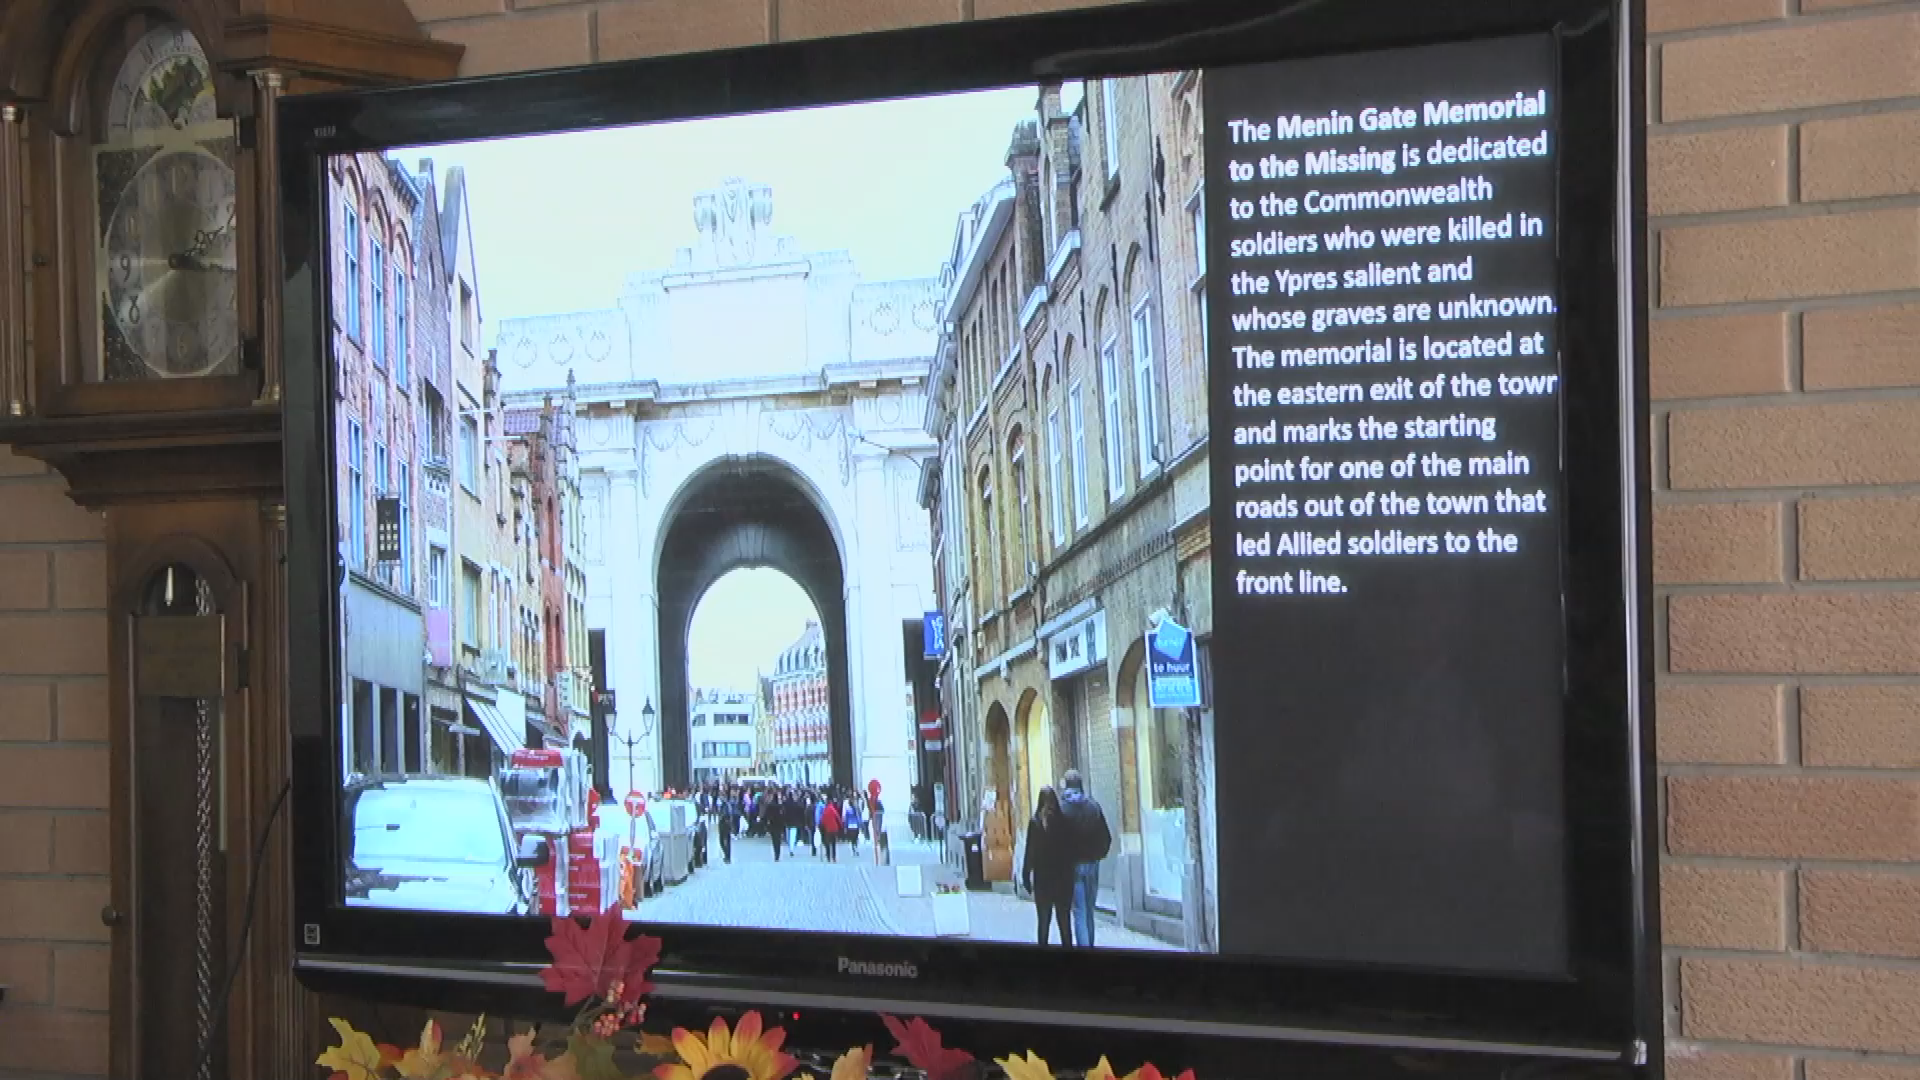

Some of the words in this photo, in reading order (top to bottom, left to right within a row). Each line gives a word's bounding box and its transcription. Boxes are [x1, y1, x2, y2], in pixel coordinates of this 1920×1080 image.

[1228, 119, 1271, 144] The
[1277, 110, 1352, 139] Menin
[1359, 107, 1417, 131] Gate
[1424, 90, 1545, 126] Memorial
[1229, 160, 1254, 182] to
[1259, 154, 1299, 178] the
[1305, 146, 1396, 175] Missing
[1403, 144, 1421, 168] is
[1427, 130, 1547, 164] dedicated
[1230, 198, 1254, 220] to
[1259, 192, 1298, 216] the
[1304, 175, 1492, 214] Commonwealth
[1231, 231, 1318, 256] soldiers
[1324, 224, 1375, 250] who
[1381, 226, 1441, 246] were
[1449, 212, 1512, 242] killed
[1520, 212, 1542, 236] in
[1231, 270, 1269, 294] the
[1275, 270, 1337, 296] Ypres
[1343, 262, 1421, 288] salient
[1428, 256, 1472, 282] and
[1232, 306, 1306, 332] whose
[1312, 306, 1387, 332] graves
[1393, 302, 1431, 322] are
[1439, 294, 1556, 320] unknown.
[1232, 346, 1275, 368] The
[1281, 338, 1391, 366] memorial
[1399, 338, 1417, 360] is
[1424, 331, 1512, 360] located
[1520, 332, 1544, 354] at
[1233, 384, 1271, 406] the
[1277, 382, 1363, 404] eastern
[1370, 376, 1413, 400] exit
[1420, 374, 1445, 398] of
[1451, 372, 1492, 398] the
[1234, 420, 1276, 444] and
[1284, 418, 1352, 442] marks
[1358, 416, 1398, 439] the
[1404, 412, 1496, 440] starting
[1235, 458, 1294, 487] point
[1299, 456, 1333, 480] for
[1339, 460, 1384, 479] one
[1391, 452, 1416, 478] of
[1421, 452, 1462, 476] the
[1469, 450, 1529, 476] main
[1236, 494, 1298, 518] roads
[1304, 494, 1344, 516] out
[1350, 492, 1375, 516] of
[1380, 490, 1420, 515] the
[1426, 492, 1488, 514] town
[1495, 488, 1546, 512] that
[1237, 532, 1270, 556] led
[1277, 530, 1341, 556] Allied
[1348, 530, 1438, 554] soldiers
[1444, 532, 1470, 552] to
[1476, 528, 1518, 552] the
[1236, 570, 1293, 594] front
[1300, 570, 1347, 592] line.
[837, 956, 918, 978] Panasonic
